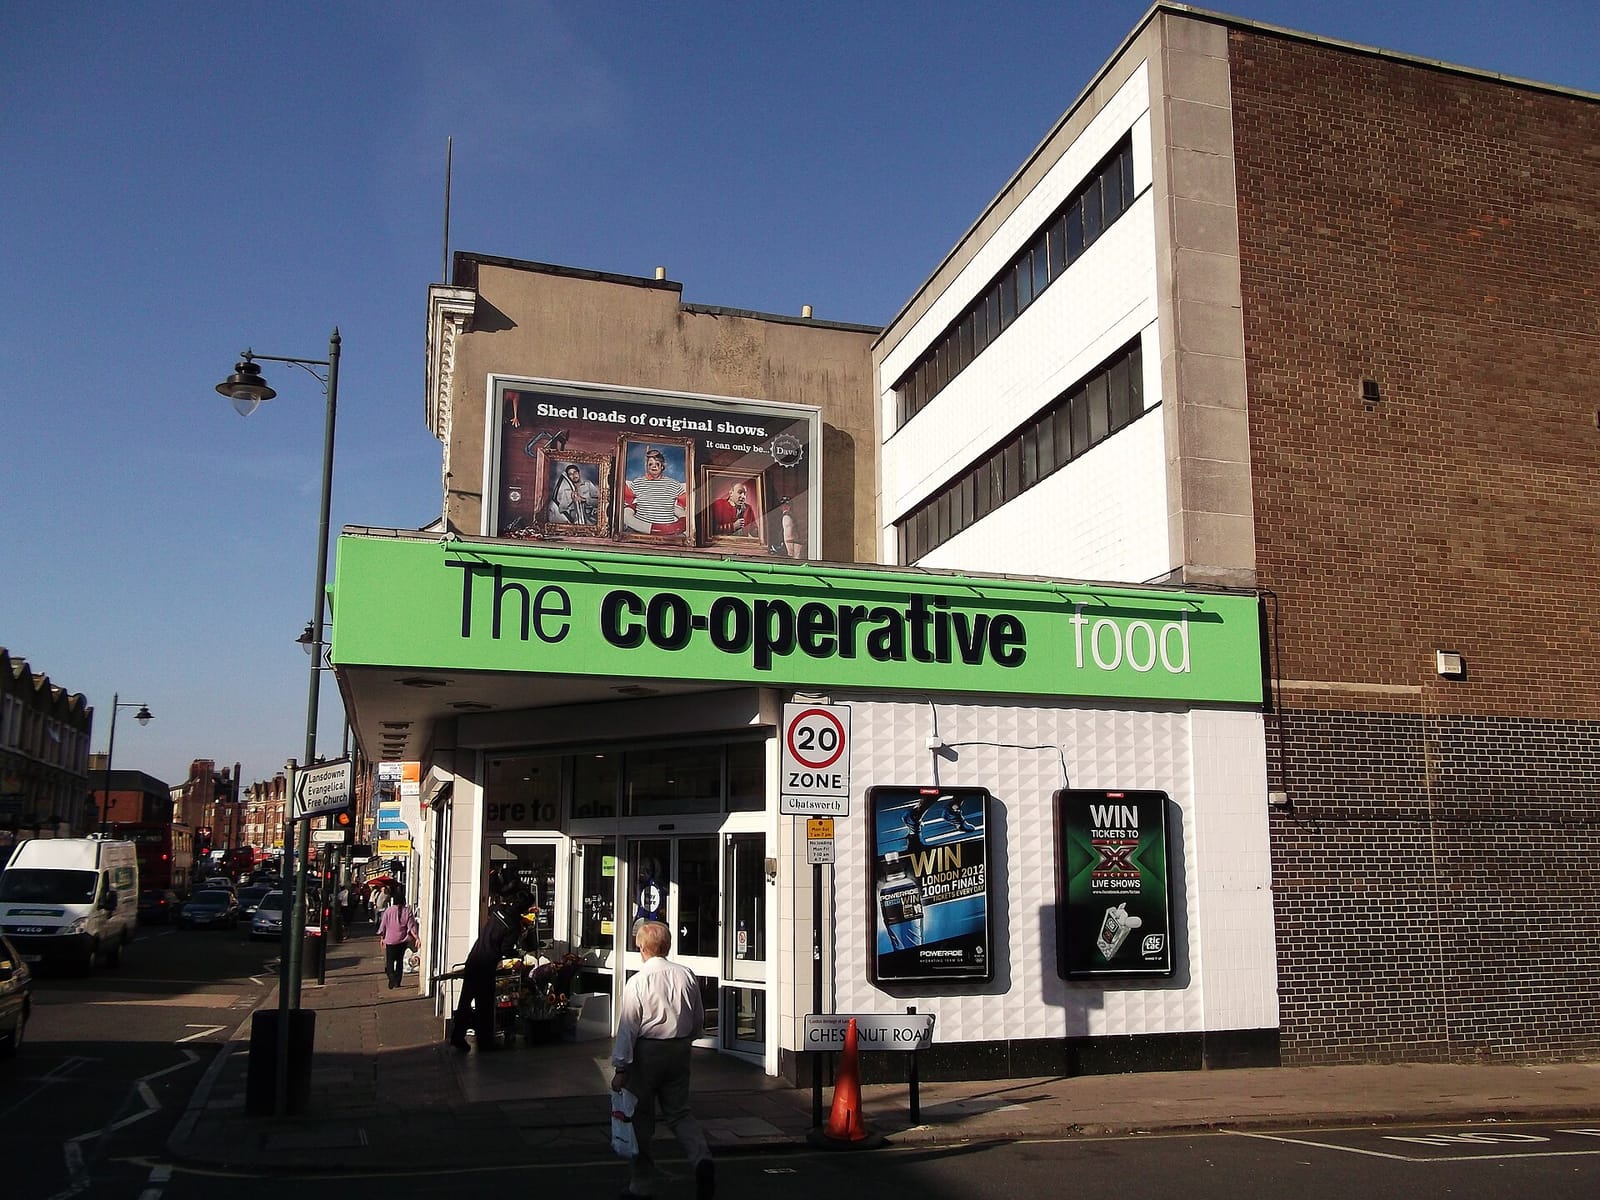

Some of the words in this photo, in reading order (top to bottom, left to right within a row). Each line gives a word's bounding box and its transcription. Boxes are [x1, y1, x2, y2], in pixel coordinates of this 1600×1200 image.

[537, 403, 578, 419] Shed
[582, 408, 626, 423] loads
[630, 413, 647, 425] of
[649, 416, 712, 432] original
[717, 421, 768, 437] shows.
[706, 440, 714, 448] It
[715, 442, 730, 450] can
[732, 444, 751, 453] only
[776, 446, 798, 455] Dave
[445, 560, 571, 644] The
[600, 589, 1026, 671] co-operative
[1069, 602, 1192, 674] food
[798, 726, 837, 751] 20
[308, 769, 345, 784] Lansdowne
[789, 773, 842, 789] ZONE
[308, 780, 346, 796] Evangelical
[307, 799, 322, 808] Free
[322, 791, 348, 806] Church
[789, 798, 841, 811] Chatsworth
[1089, 805, 1138, 828] WIN
[1091, 830, 1125, 838] TICKETS
[1127, 830, 1139, 838] TO
[910, 844, 961, 877] WIN
[922, 870, 959, 886] LONDON
[961, 863, 985, 877] 2012
[922, 884, 950, 897] 100m
[952, 874, 985, 890] FINALS
[1092, 880, 1109, 888] LIVE
[1111, 880, 1140, 888] SHOWS
[880, 888, 919, 900] POWERADE
[901, 894, 920, 905] WIN
[933, 892, 956, 902] TICKETS
[956, 887, 973, 897] EVERY
[973, 884, 985, 893] DAY
[809, 1029, 887, 1042] CHESNUT
[894, 1029, 930, 1042] ROAD
